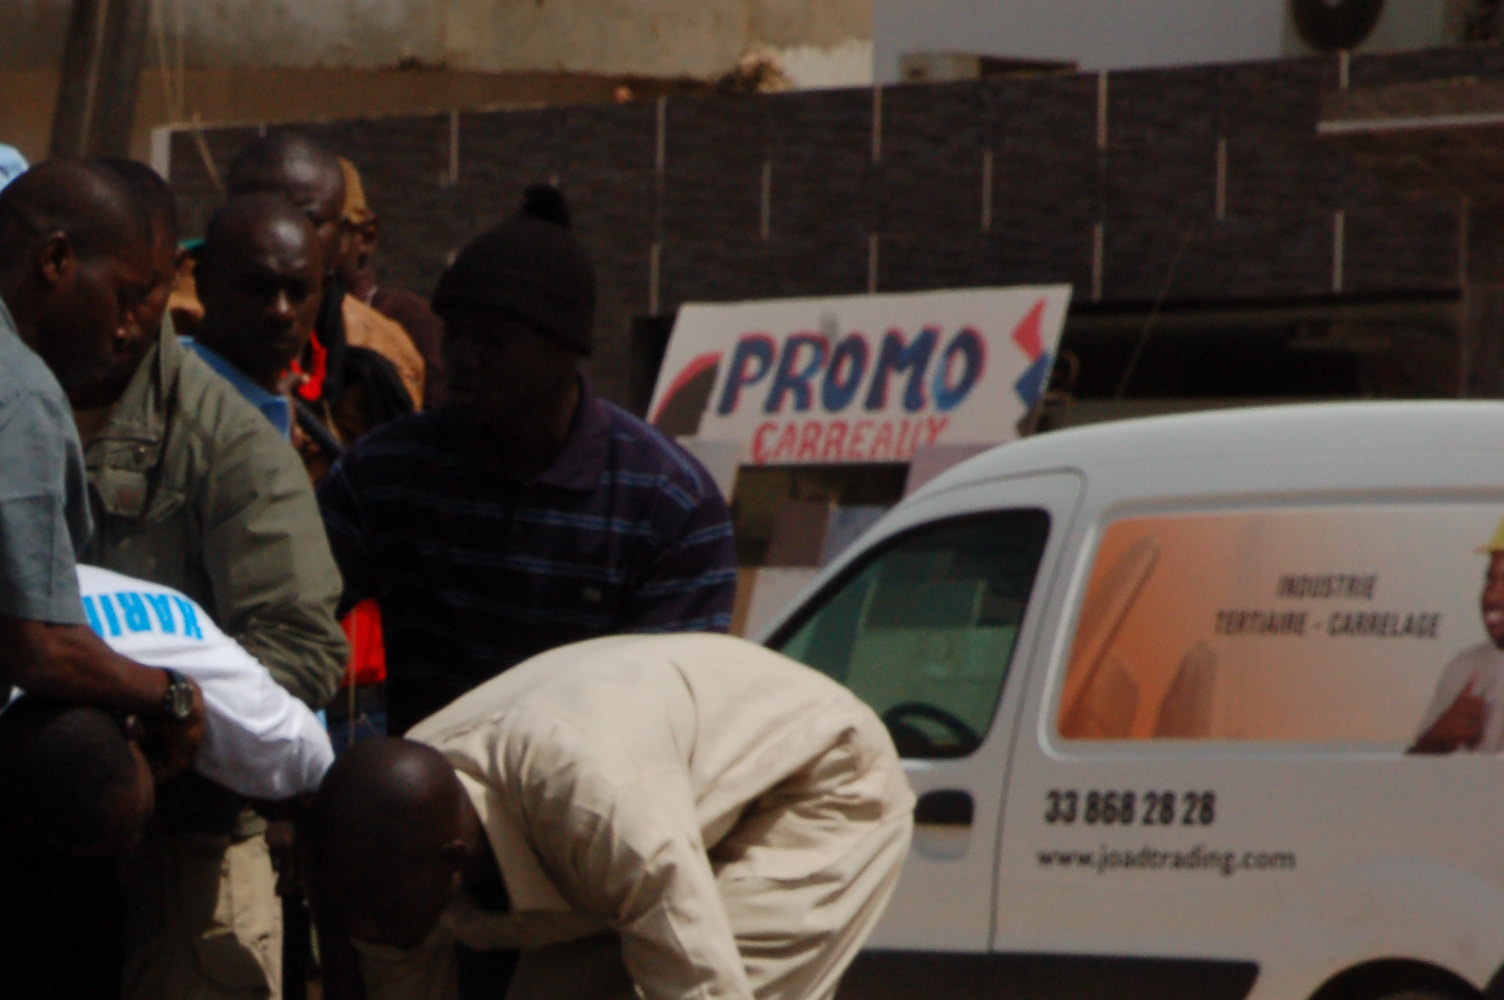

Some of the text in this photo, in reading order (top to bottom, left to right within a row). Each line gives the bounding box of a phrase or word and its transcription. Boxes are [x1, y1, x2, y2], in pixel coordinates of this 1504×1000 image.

[717, 325, 987, 416] PROMO
[1277, 574, 1377, 599] INDUSTRIE
[1215, 610, 1307, 636] TERTIAIRE
[1327, 611, 1441, 638] CARRELAGE
[1045, 790, 1215, 825] 33 868 28 28
[1038, 844, 1295, 876] www.joadtrading.com
